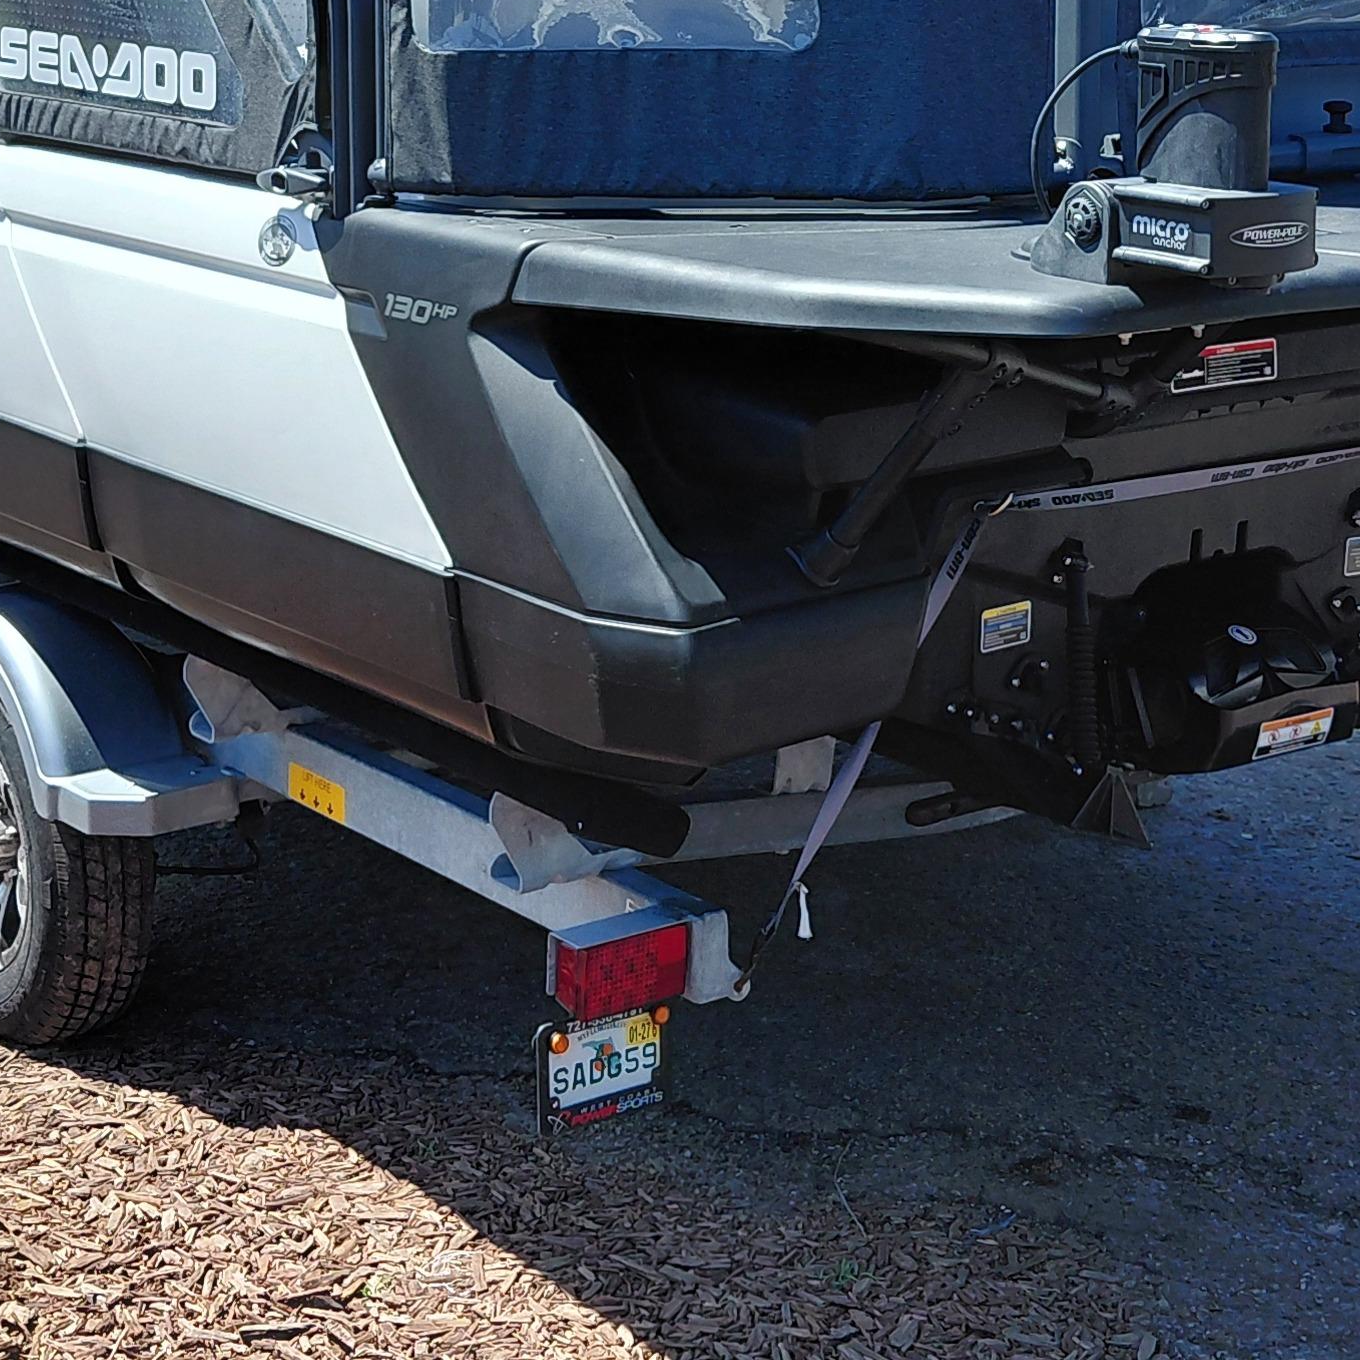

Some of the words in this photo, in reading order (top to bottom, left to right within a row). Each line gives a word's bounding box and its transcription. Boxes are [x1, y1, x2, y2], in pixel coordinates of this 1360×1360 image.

[1133, 214, 1189, 241] micro
[1153, 236, 1187, 251] anchor
[553, 1042, 657, 1095] SADG59
